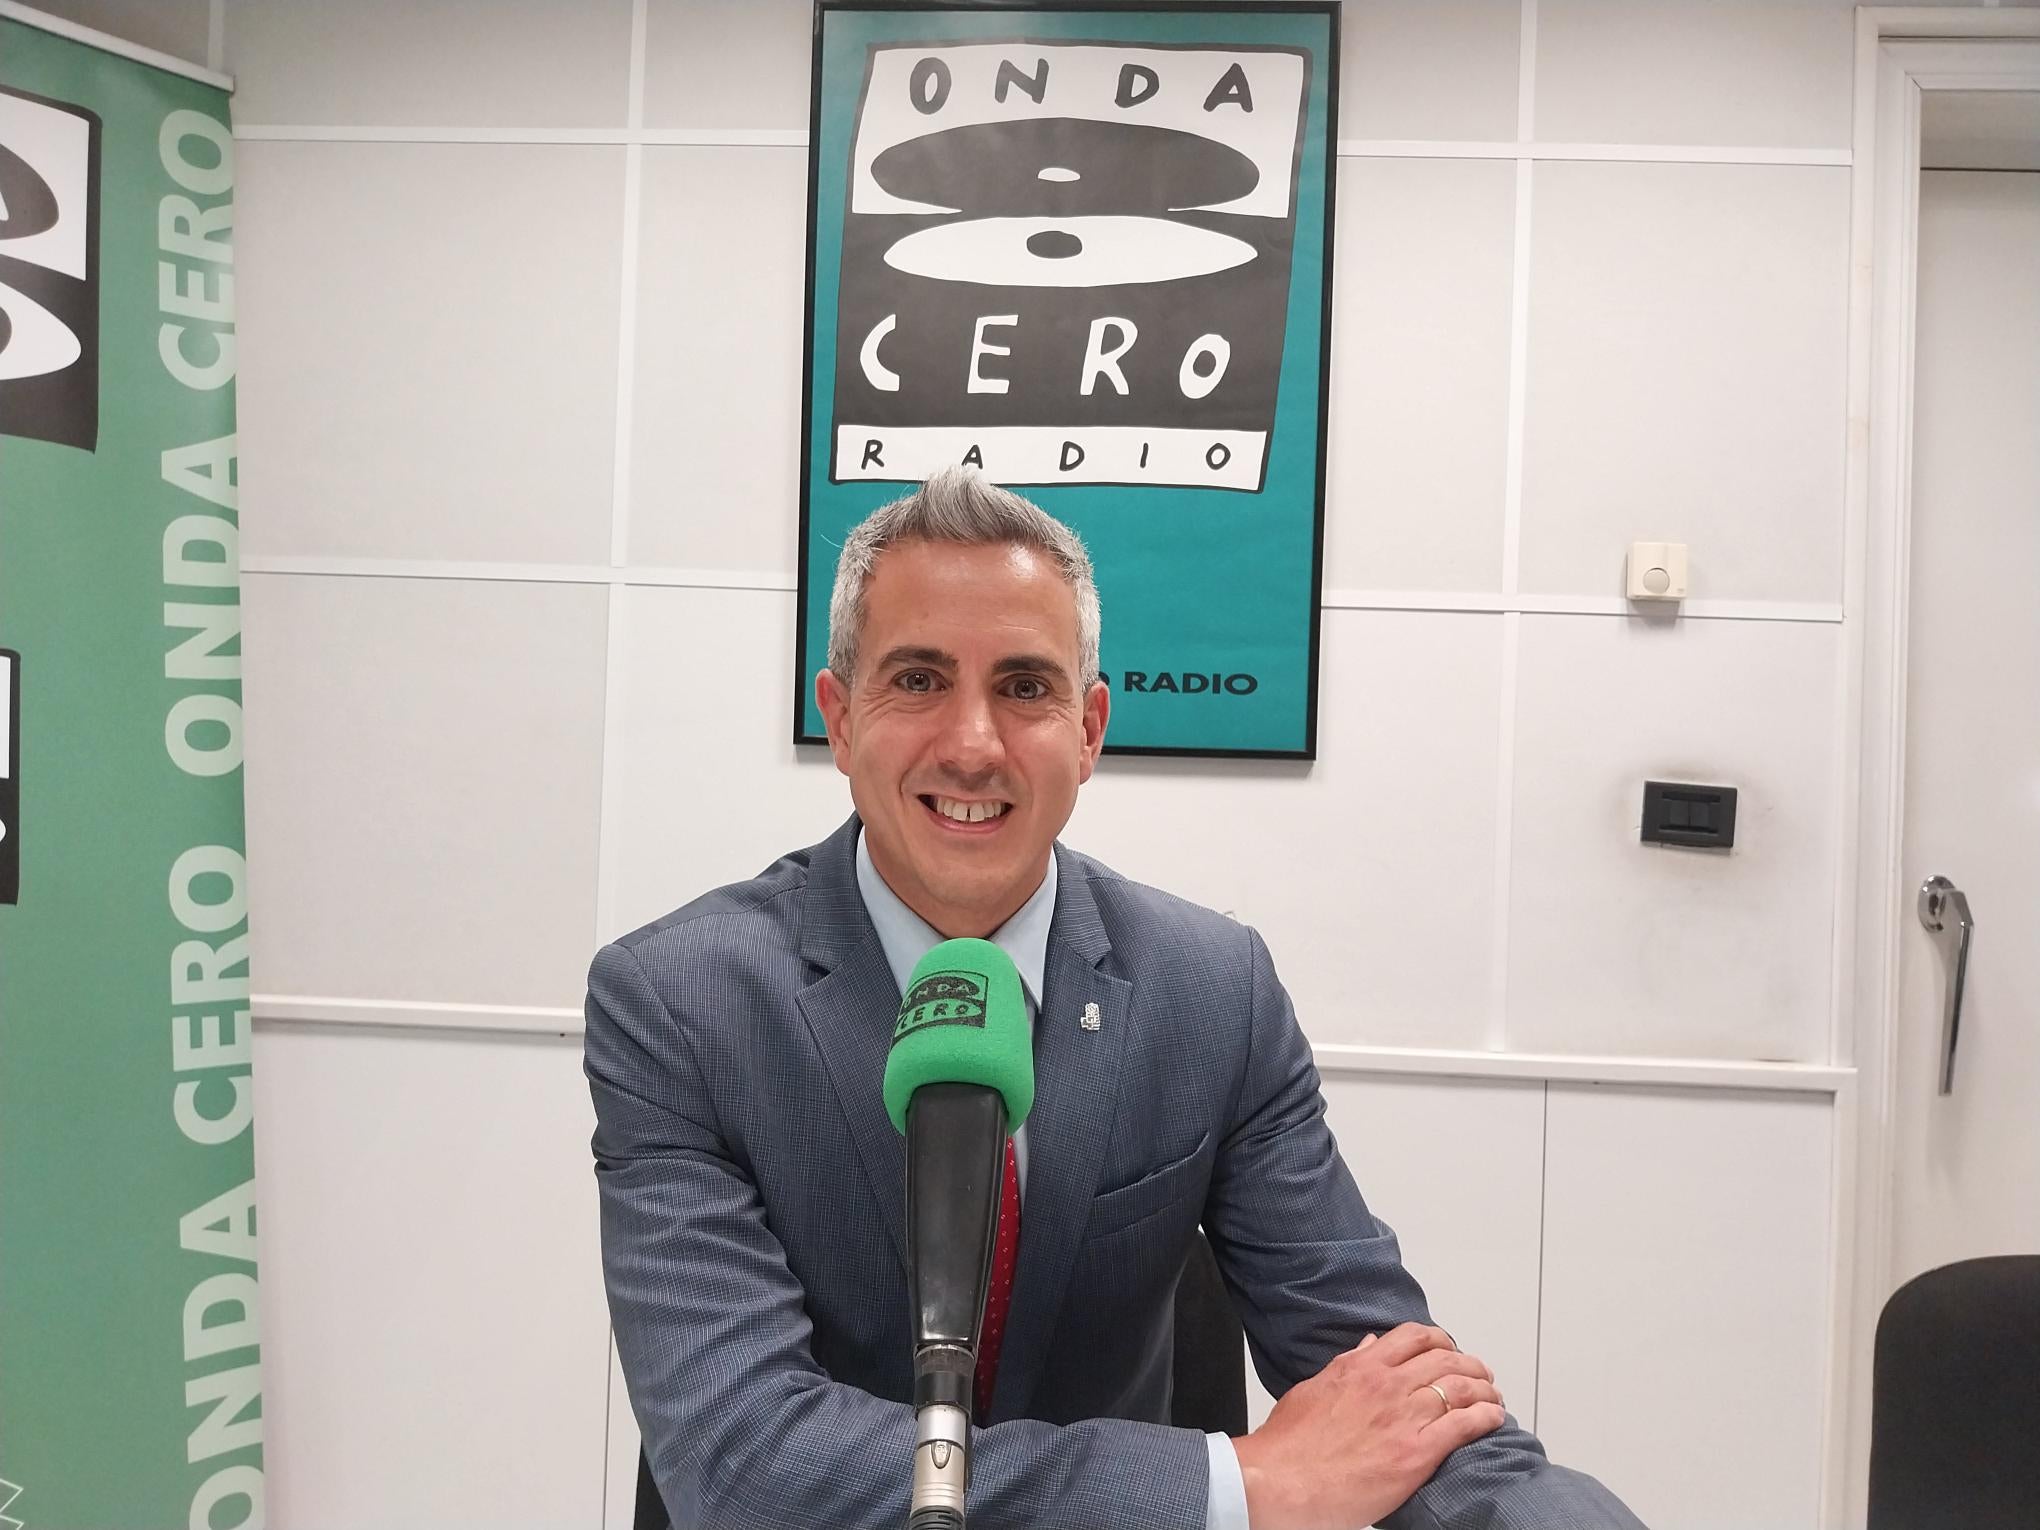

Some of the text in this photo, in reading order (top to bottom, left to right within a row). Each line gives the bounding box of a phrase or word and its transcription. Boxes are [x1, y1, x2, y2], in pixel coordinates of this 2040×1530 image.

[909, 57, 1253, 114] ONDA
[860, 314, 1231, 399] CERO
[861, 439, 1231, 471] RADIO
[1123, 671, 1258, 695] RADIO
[158, 108, 266, 1530] ONDA CERO ONDA CERO
